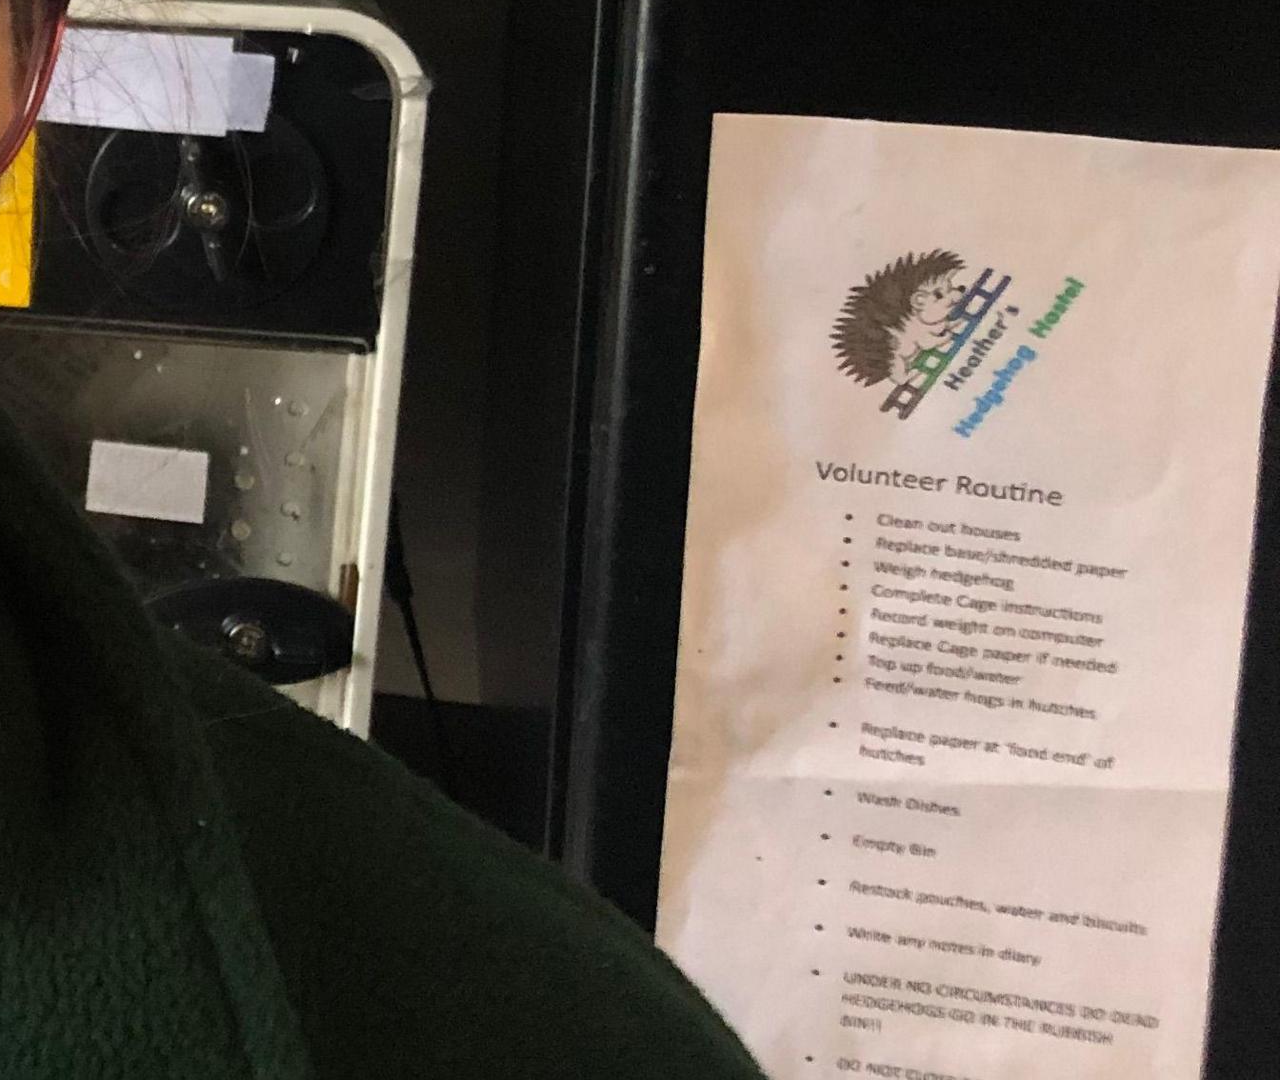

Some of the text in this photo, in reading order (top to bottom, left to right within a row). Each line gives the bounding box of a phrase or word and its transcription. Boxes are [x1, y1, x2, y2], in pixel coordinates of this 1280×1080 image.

[943, 304, 1020, 391] Heather's
[952, 276, 1085, 438] Hedgehog Hostel
[815, 461, 1064, 507] Volunteer Routine
[877, 513, 1021, 542] Clean out houses
[873, 560, 1015, 592] Weigh hedgehog
[875, 536, 1128, 579] Replace base/shredded paper
[871, 583, 1104, 625] Complete Cage instructions
[870, 607, 1104, 648] Record weight on computer
[868, 631, 1119, 674] Replace Cage paper if needed
[868, 654, 1021, 686] Top up food/water
[964, 690, 1004, 710] hogs
[1010, 696, 1025, 709] in
[1028, 699, 1097, 720] hutches
[858, 745, 926, 767] hutches
[861, 722, 926, 743] Replace
[929, 734, 979, 753] paper
[984, 740, 1000, 753] at
[1094, 755, 1117, 769] of
[856, 791, 961, 817] Wash Dishes
[852, 834, 937, 859] Empty Bin
[849, 880, 913, 901] Restock
[994, 904, 1044, 919] water
[1049, 911, 1080, 925] and
[847, 926, 892, 944] Write
[929, 939, 975, 956] notes
[979, 945, 995, 957] in
[998, 948, 1042, 967] diary
[843, 971, 902, 991] UNDER
[906, 981, 933, 996] NO
[842, 993, 945, 1019] HEDGEHOGS
